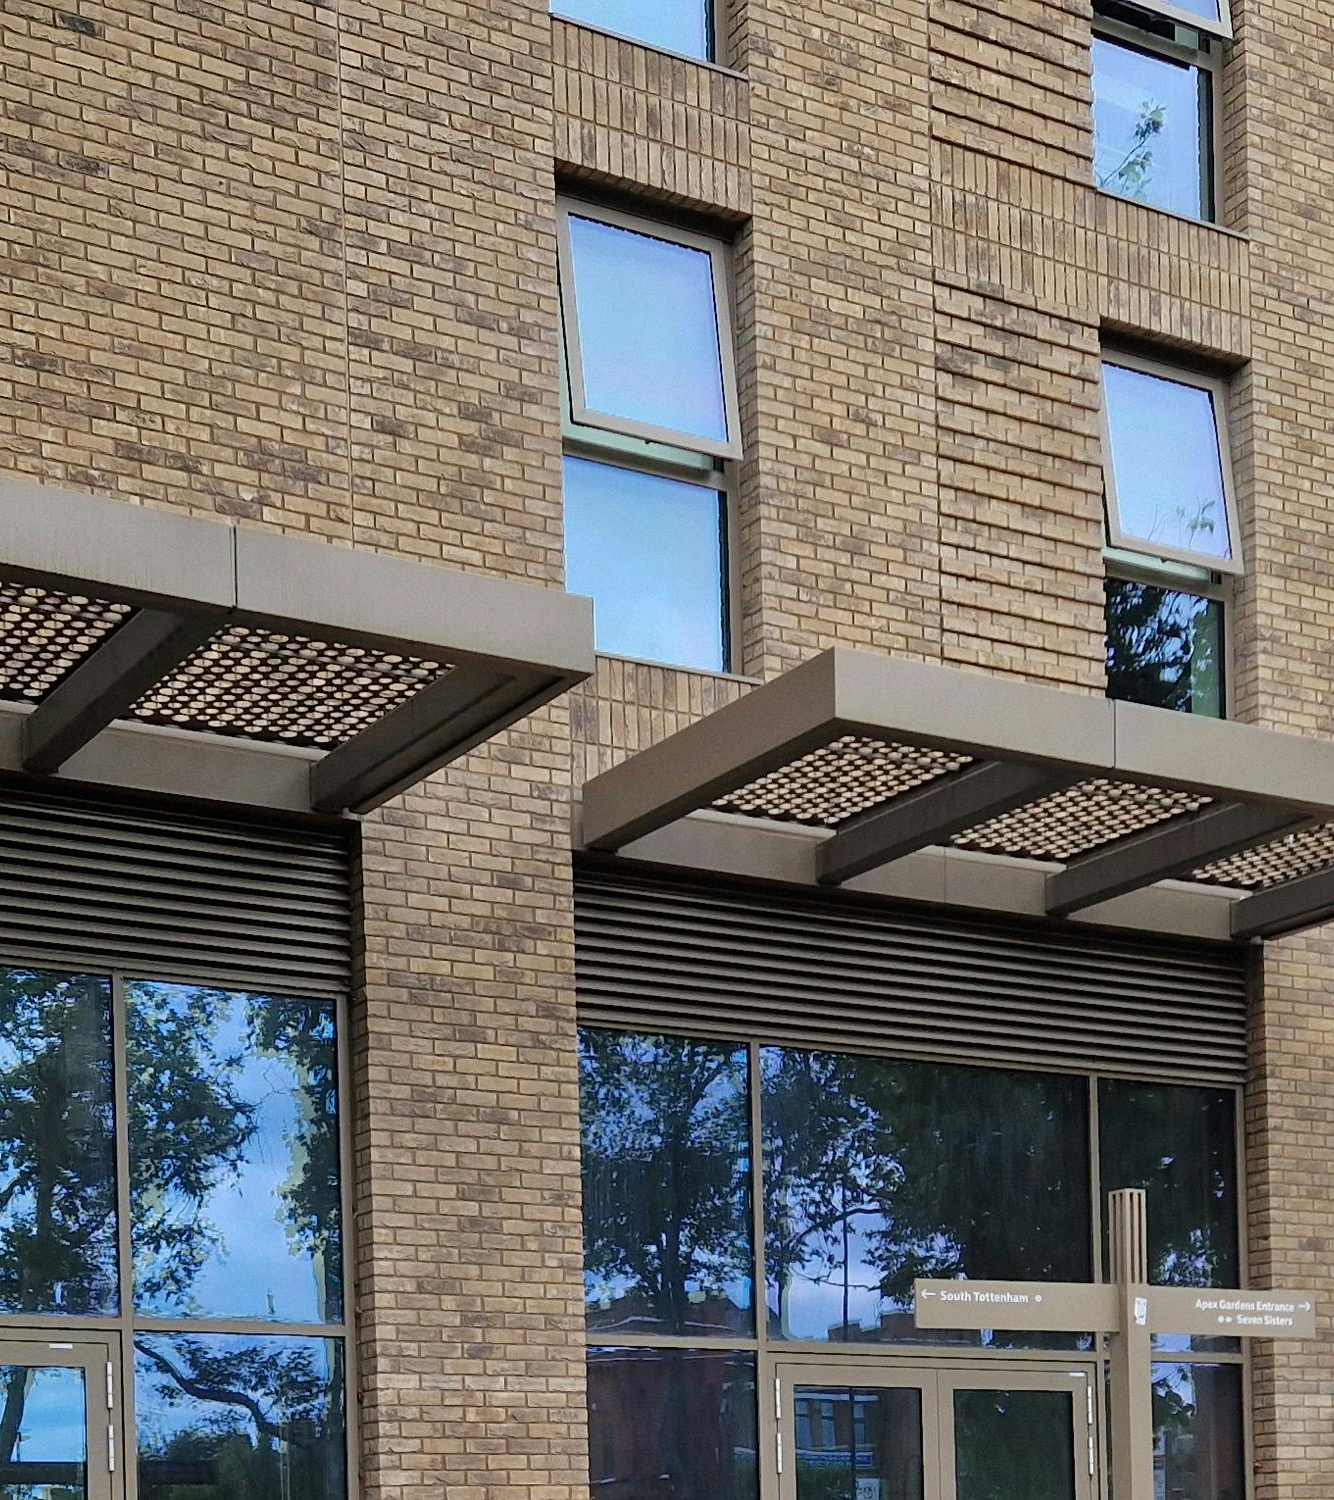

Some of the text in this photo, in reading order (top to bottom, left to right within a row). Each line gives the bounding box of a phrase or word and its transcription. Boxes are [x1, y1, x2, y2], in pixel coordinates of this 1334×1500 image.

[940, 1290, 1029, 1303] South Tottenham
[1195, 1299, 1295, 1313] Apex Gardens Entrance
[1236, 1314, 1294, 1327] Seven Sisters
